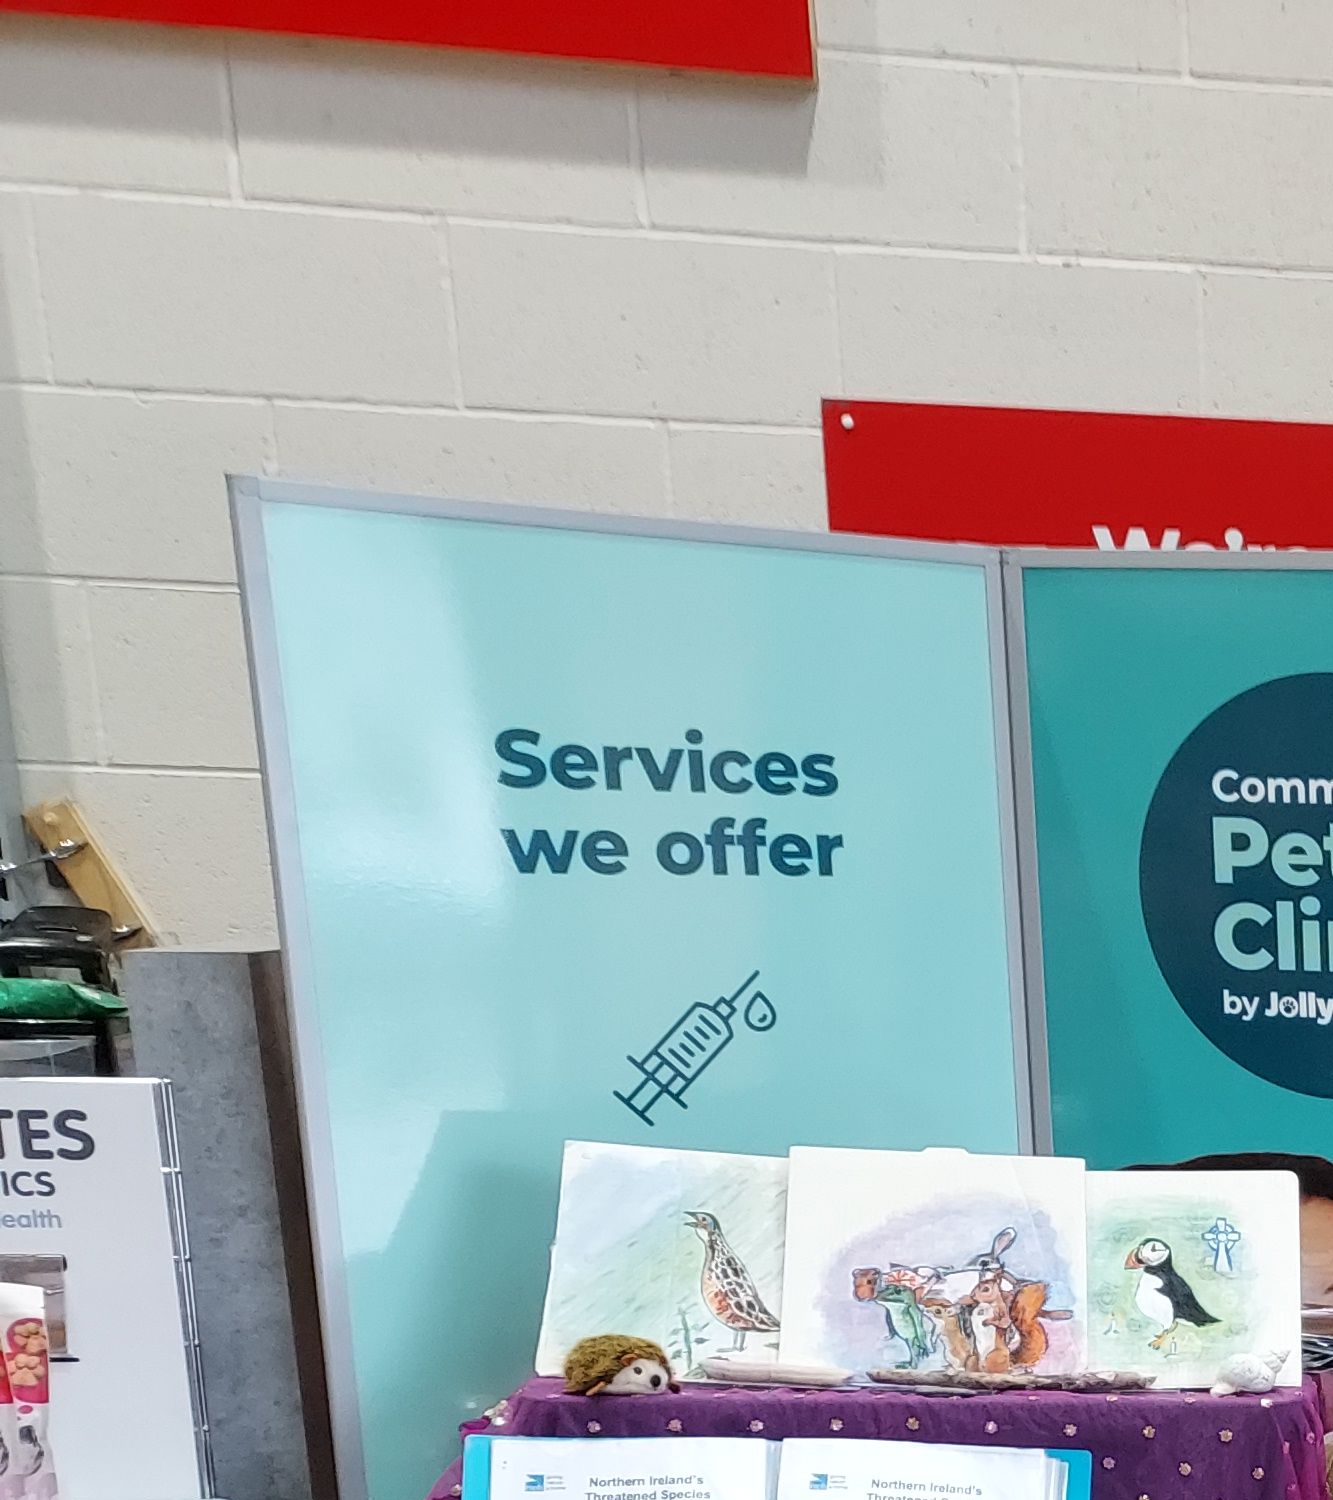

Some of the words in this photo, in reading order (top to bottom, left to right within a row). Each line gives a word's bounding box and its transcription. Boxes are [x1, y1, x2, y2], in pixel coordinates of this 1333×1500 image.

[494, 728, 840, 798] Services
[500, 826, 628, 876] we
[656, 818, 844, 878] offer
[1222, 991, 1260, 1020] by
[589, 1476, 645, 1488] Northern
[649, 1474, 704, 1486] Ireland's
[871, 1479, 926, 1492] Northern
[930, 1482, 983, 1496] Ireland's
